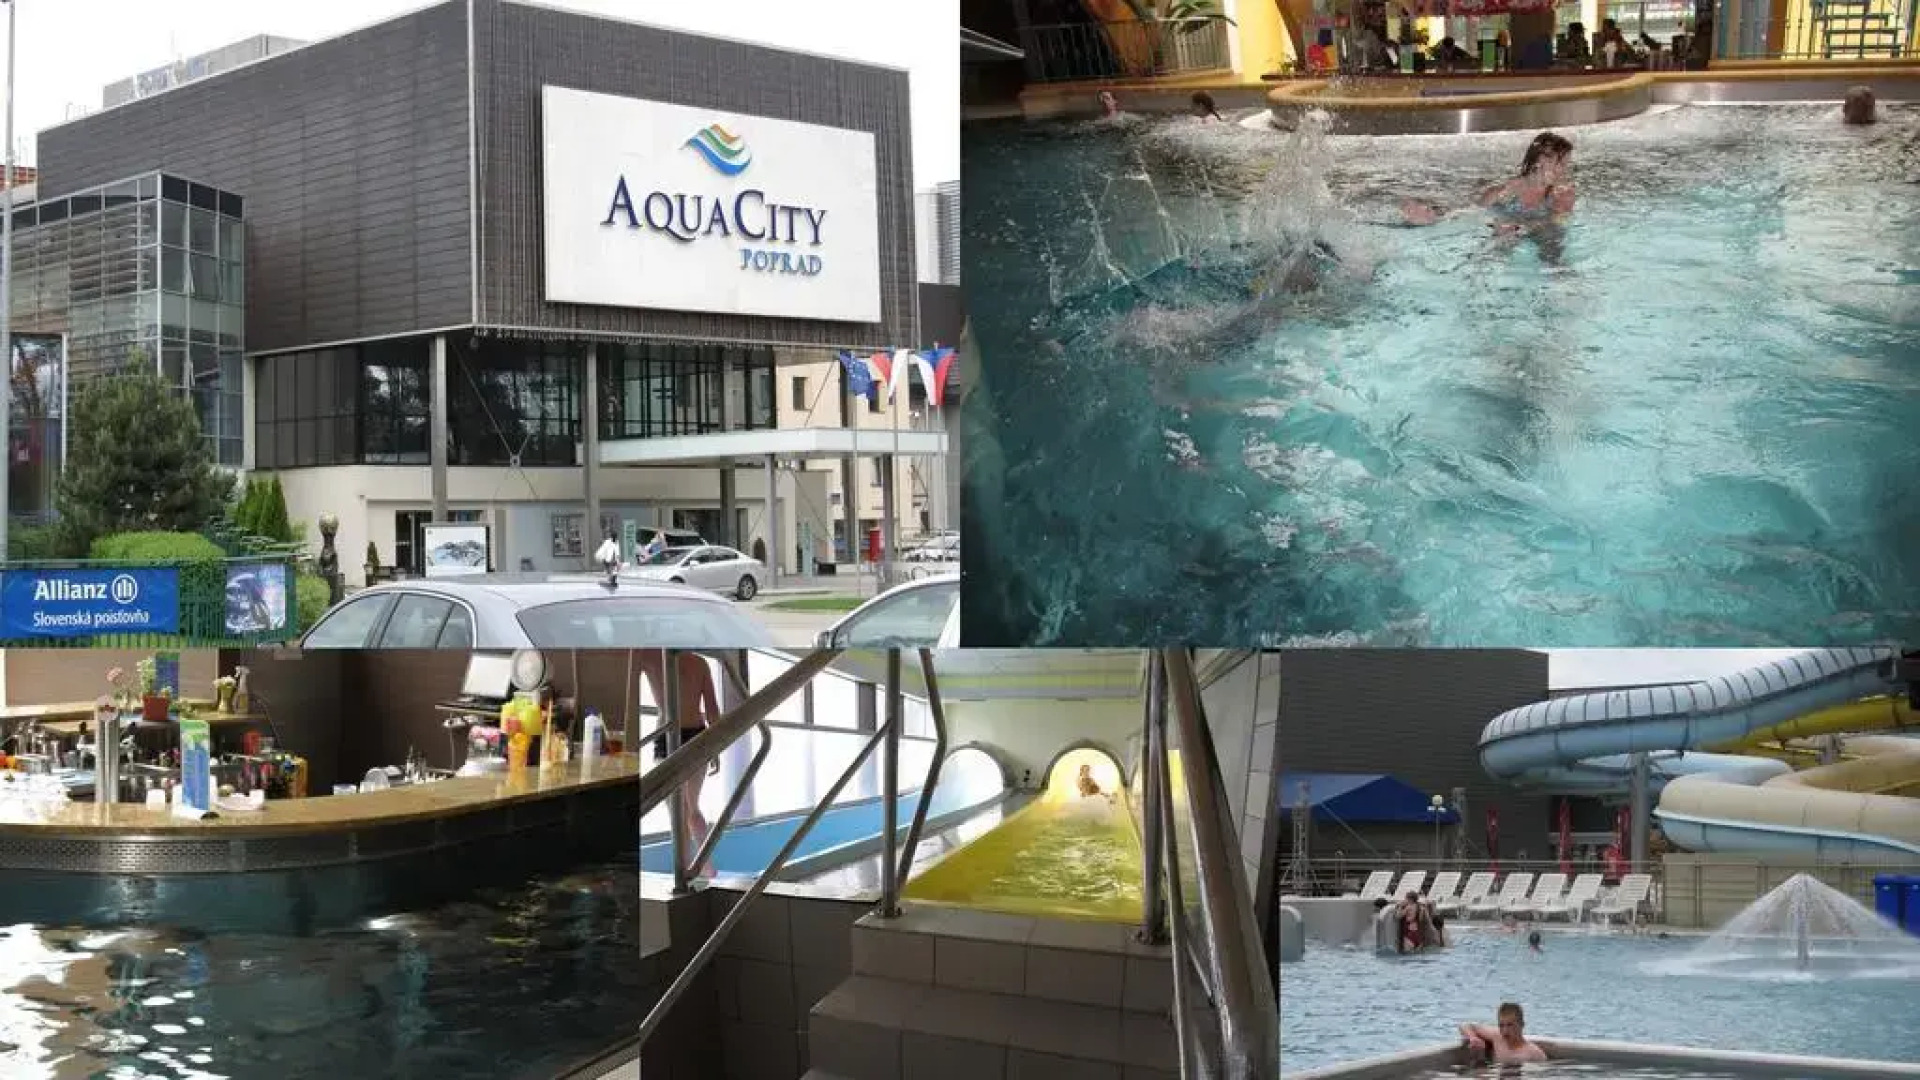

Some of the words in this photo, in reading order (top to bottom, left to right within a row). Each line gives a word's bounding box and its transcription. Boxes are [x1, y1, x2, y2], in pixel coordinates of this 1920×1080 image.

[739, 248, 823, 276] POPRAD
[33, 579, 108, 601] Allianz
[33, 609, 91, 627] Slovenská
